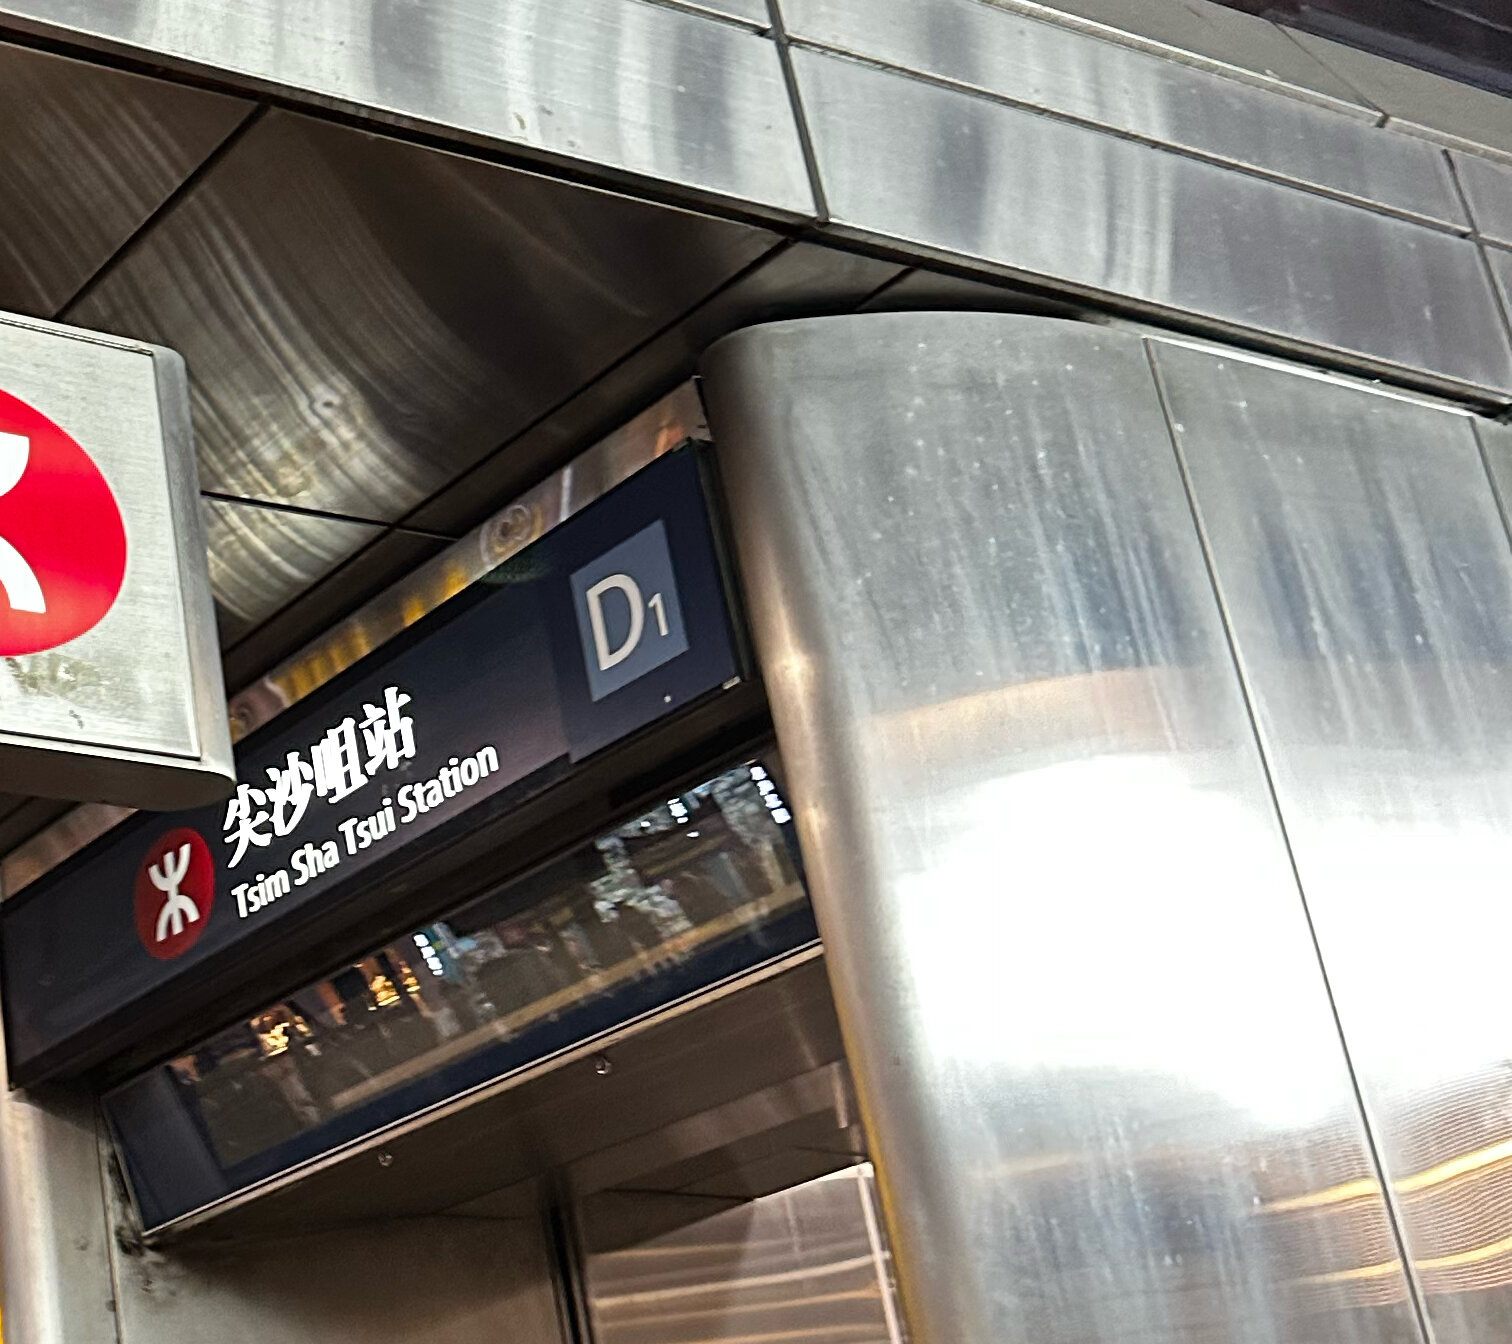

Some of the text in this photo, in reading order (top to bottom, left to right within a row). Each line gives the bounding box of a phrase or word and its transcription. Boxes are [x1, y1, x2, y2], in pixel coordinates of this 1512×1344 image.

[585, 573, 672, 673] D1
[223, 686, 416, 868] 尖沙咀站
[231, 745, 500, 918] Tsim Sha Tsui Station
